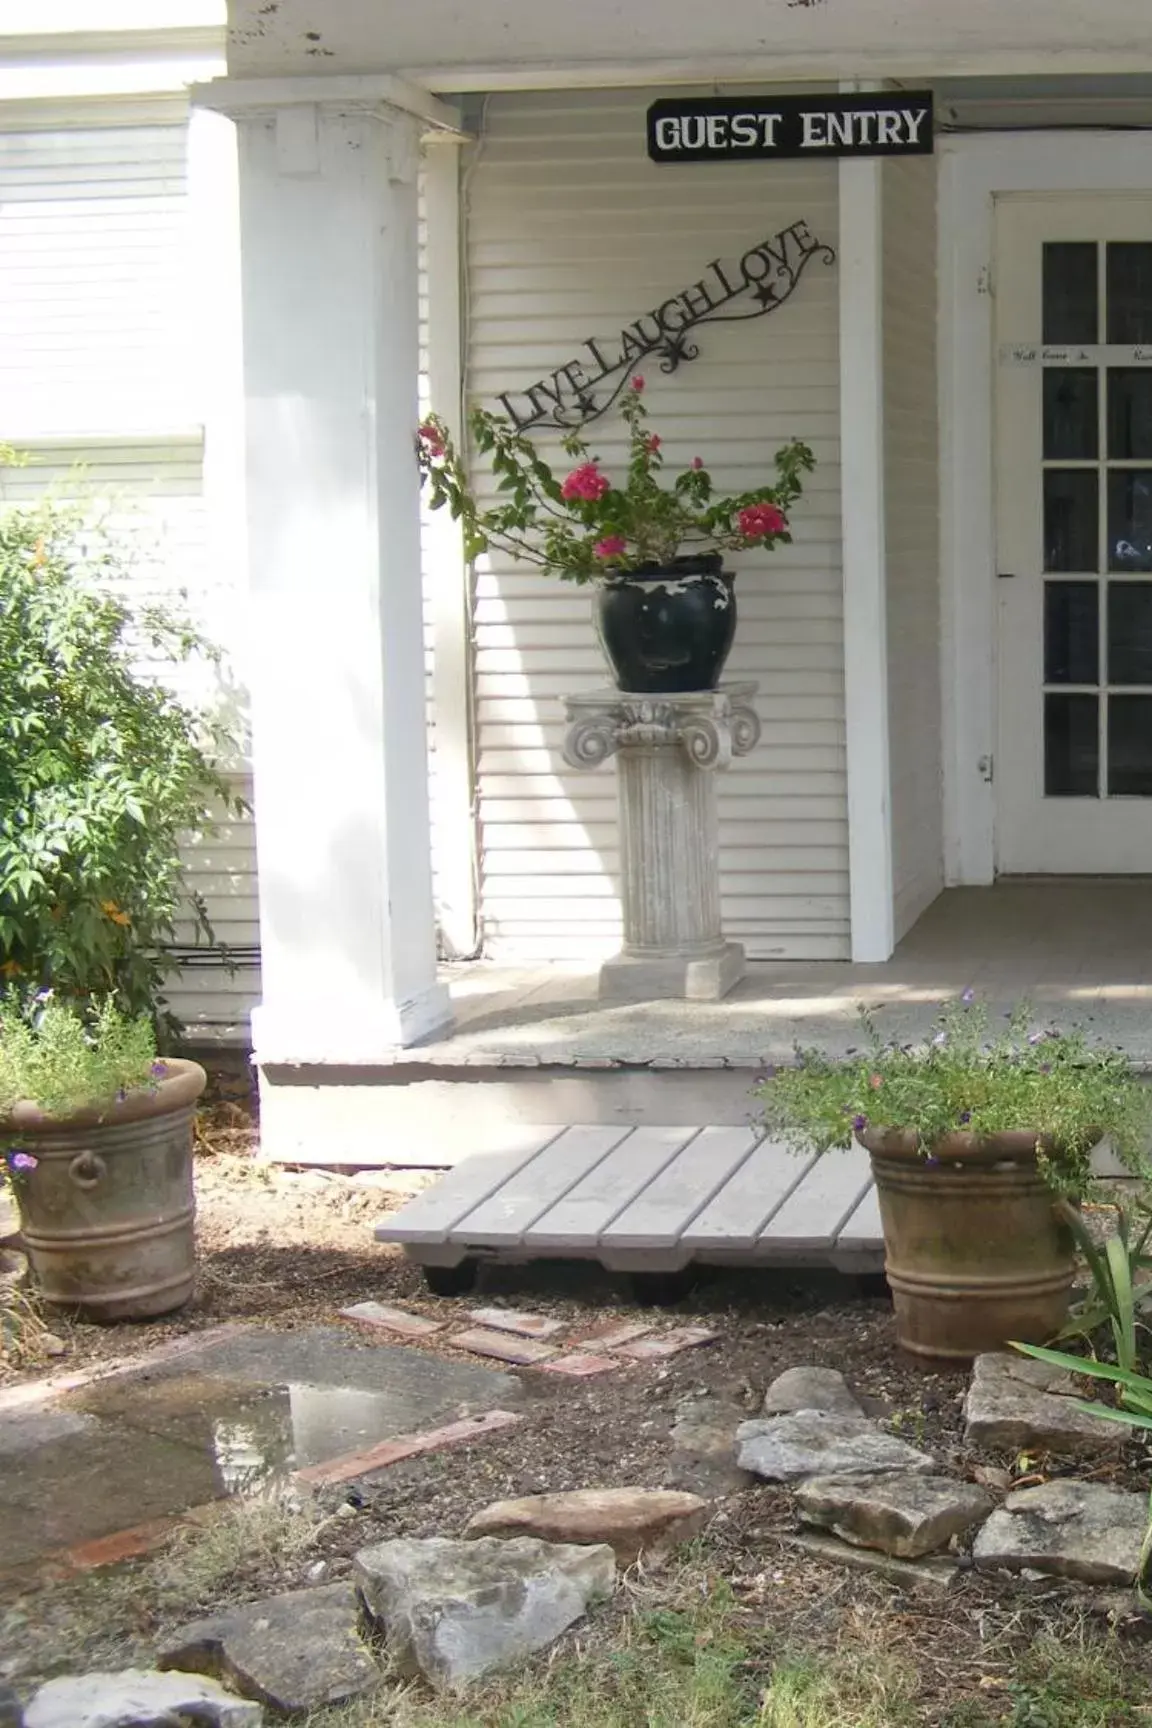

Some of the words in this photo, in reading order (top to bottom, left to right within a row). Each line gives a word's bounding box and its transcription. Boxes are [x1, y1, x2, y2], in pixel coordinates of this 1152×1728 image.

[654, 113, 783, 150] GUEST
[798, 109, 928, 147] ENTRY
[498, 360, 592, 430] LIVE
[584, 281, 717, 375] LAUGH
[708, 220, 819, 298] LOVE
